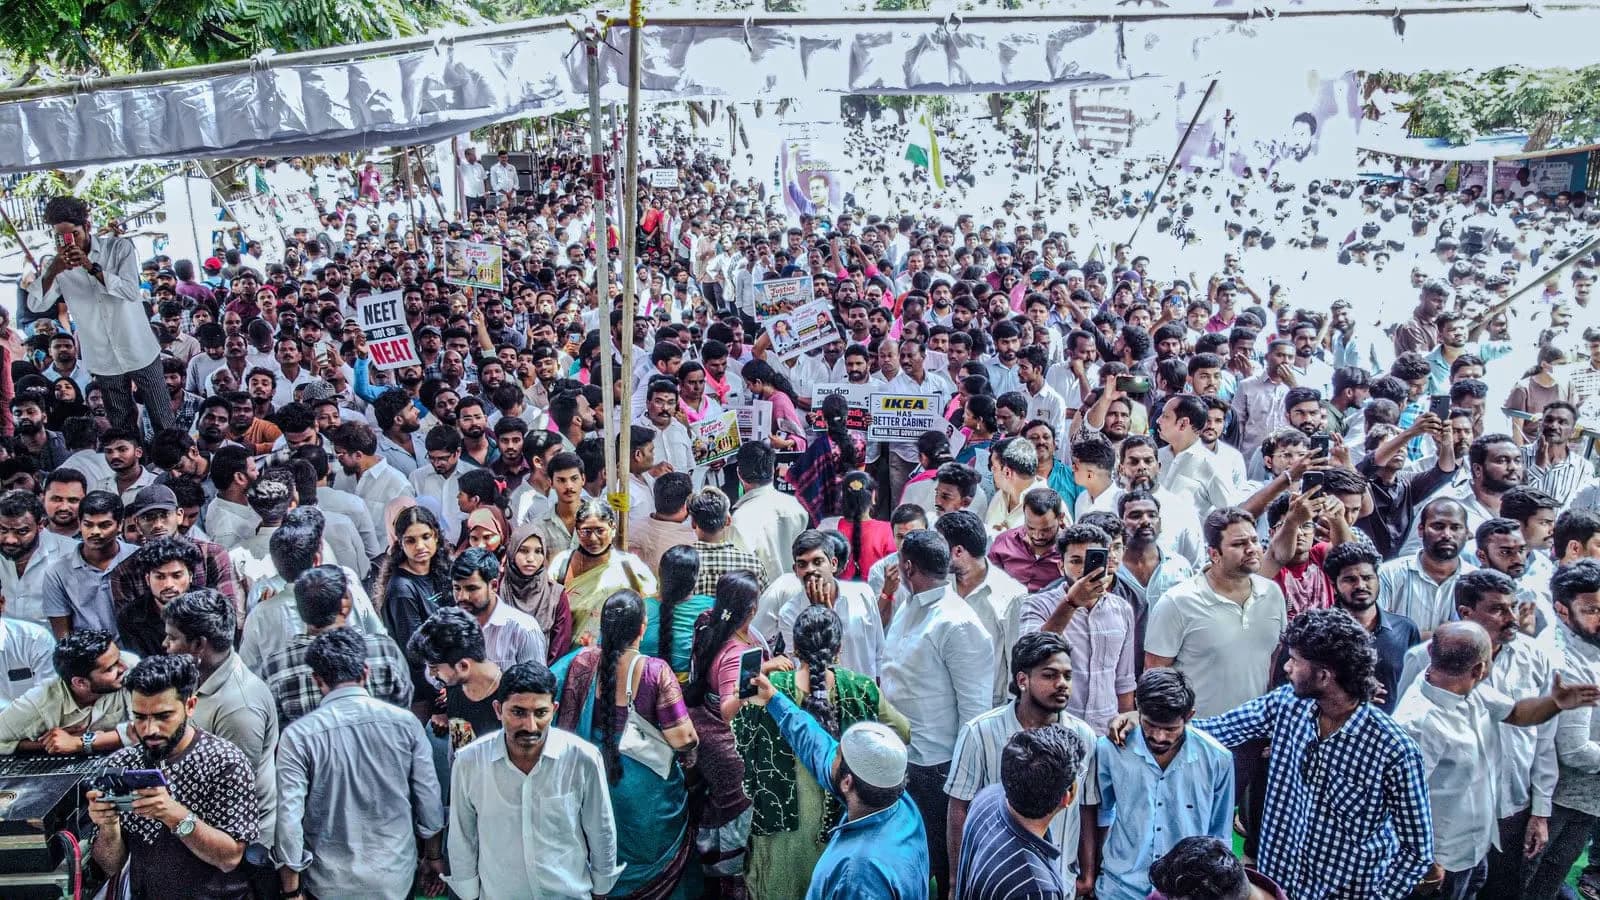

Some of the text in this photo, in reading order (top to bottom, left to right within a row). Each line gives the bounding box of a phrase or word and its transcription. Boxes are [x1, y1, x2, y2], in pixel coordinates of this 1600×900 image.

[769, 285, 796, 296] Justice
[363, 299, 397, 326] NEET
[372, 326, 396, 339] not so
[368, 338, 413, 365] NEAT
[884, 399, 924, 410] IKEA
[896, 410, 912, 418] HAS
[874, 416, 901, 427] BETTER
[699, 420, 721, 436] Future
